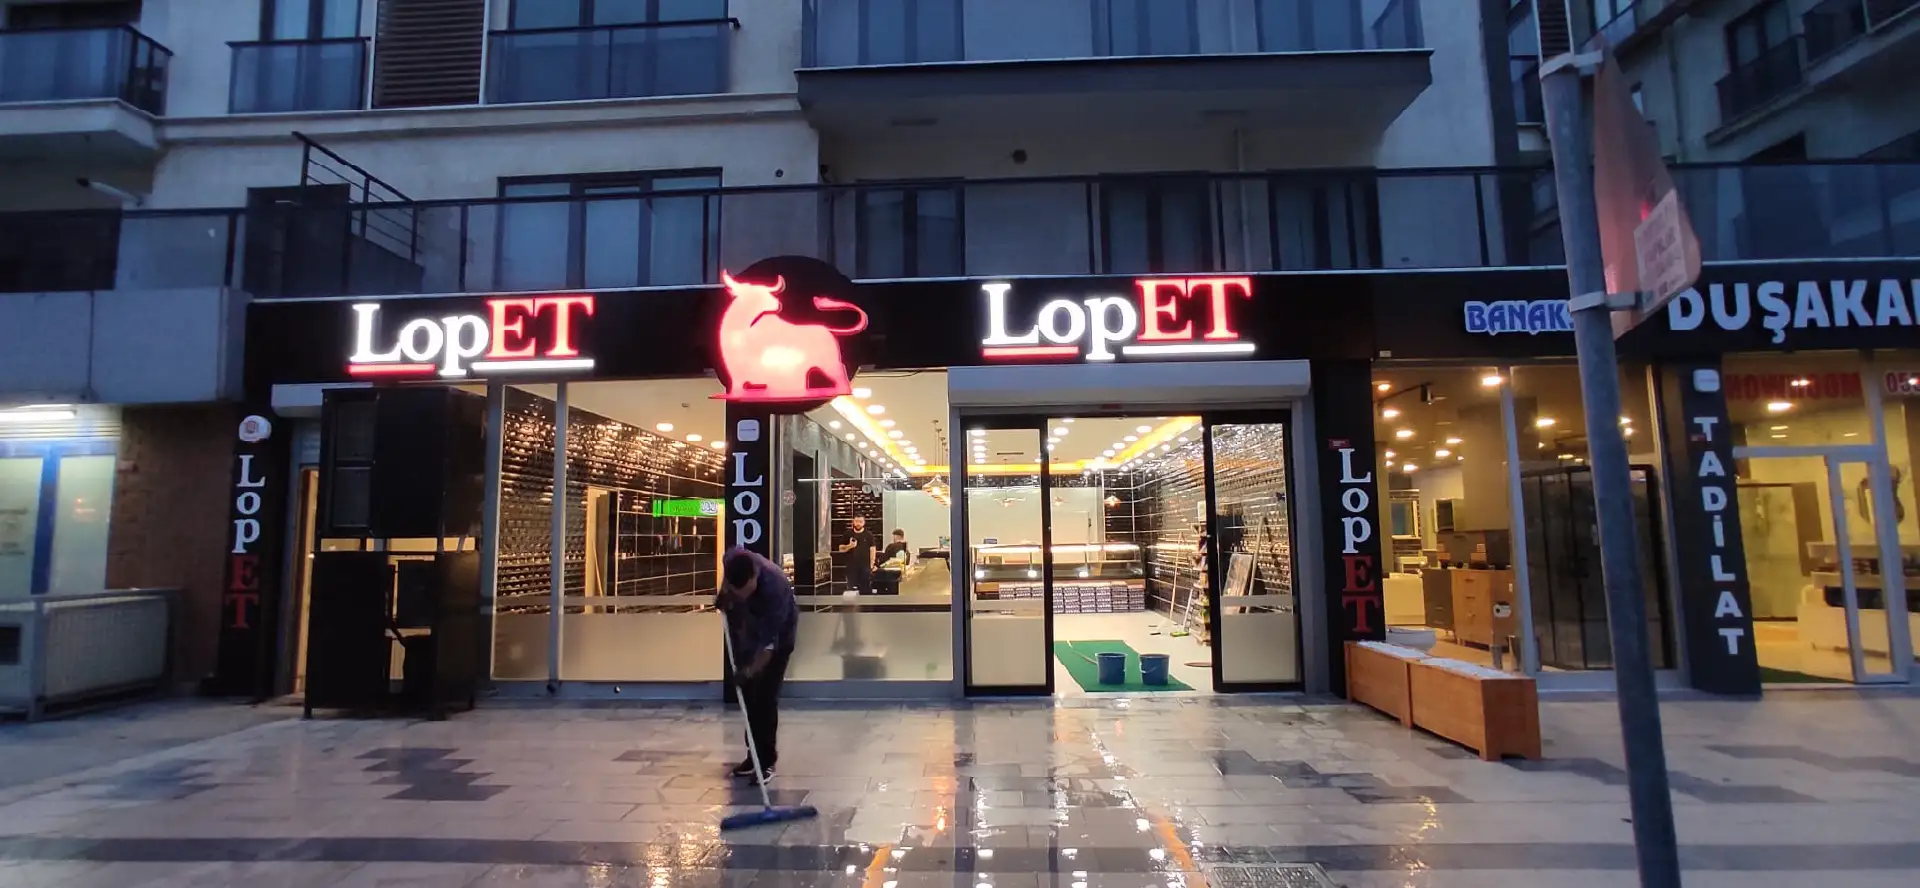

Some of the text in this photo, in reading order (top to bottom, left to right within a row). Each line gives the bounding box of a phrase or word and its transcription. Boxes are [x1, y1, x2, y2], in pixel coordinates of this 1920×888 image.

[349, 296, 594, 377] LopET
[982, 276, 1252, 361] LopET
[1464, 300, 1576, 336] BANAK
[1668, 279, 1920, 344] DUŞAKA
[226, 454, 266, 628] LopET
[1338, 449, 1379, 634] LopET
[1693, 416, 1744, 655] TADİLAT
